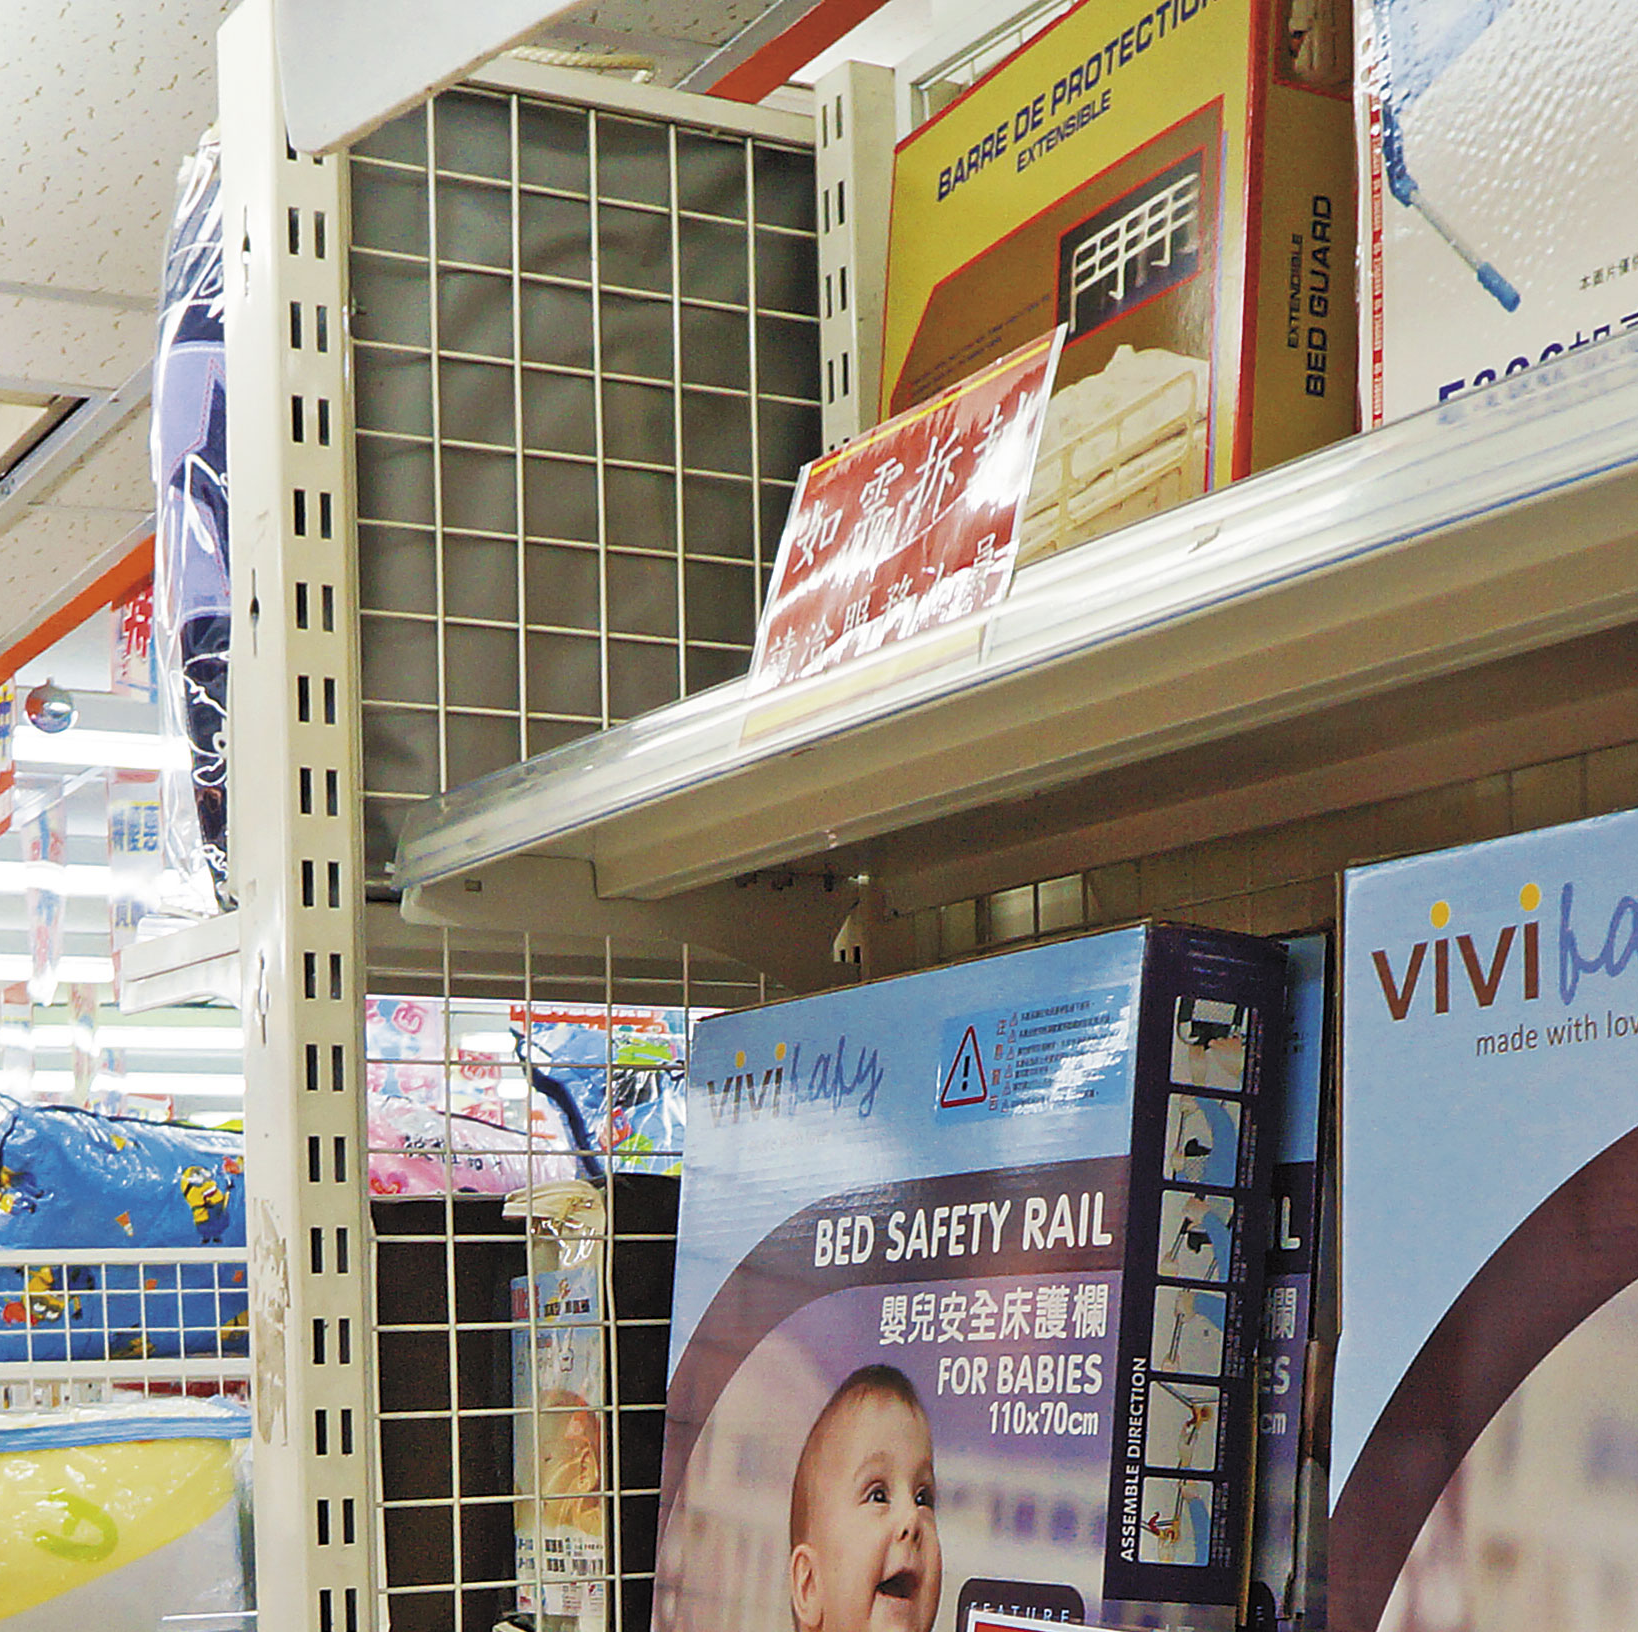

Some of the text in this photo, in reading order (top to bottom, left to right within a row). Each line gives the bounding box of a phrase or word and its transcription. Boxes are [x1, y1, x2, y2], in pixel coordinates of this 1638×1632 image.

[937, 0, 1221, 201] BARRE DE PROTECTIO
[1017, 89, 1112, 173] EXTENSIBLE
[1306, 194, 1333, 398] BED GUARD
[1475, 1021, 1538, 1058] made
[1547, 1011, 1599, 1048] with
[813, 1190, 1113, 1269] BED SAFETY RAIL
[879, 1283, 1109, 1346] 嬰兒安全床護欄
[936, 1353, 1103, 1398] FOR BABIES
[988, 1400, 1099, 1437] 110x70cm
[1119, 1356, 1147, 1566] ASSEMBLE DIRECTION
